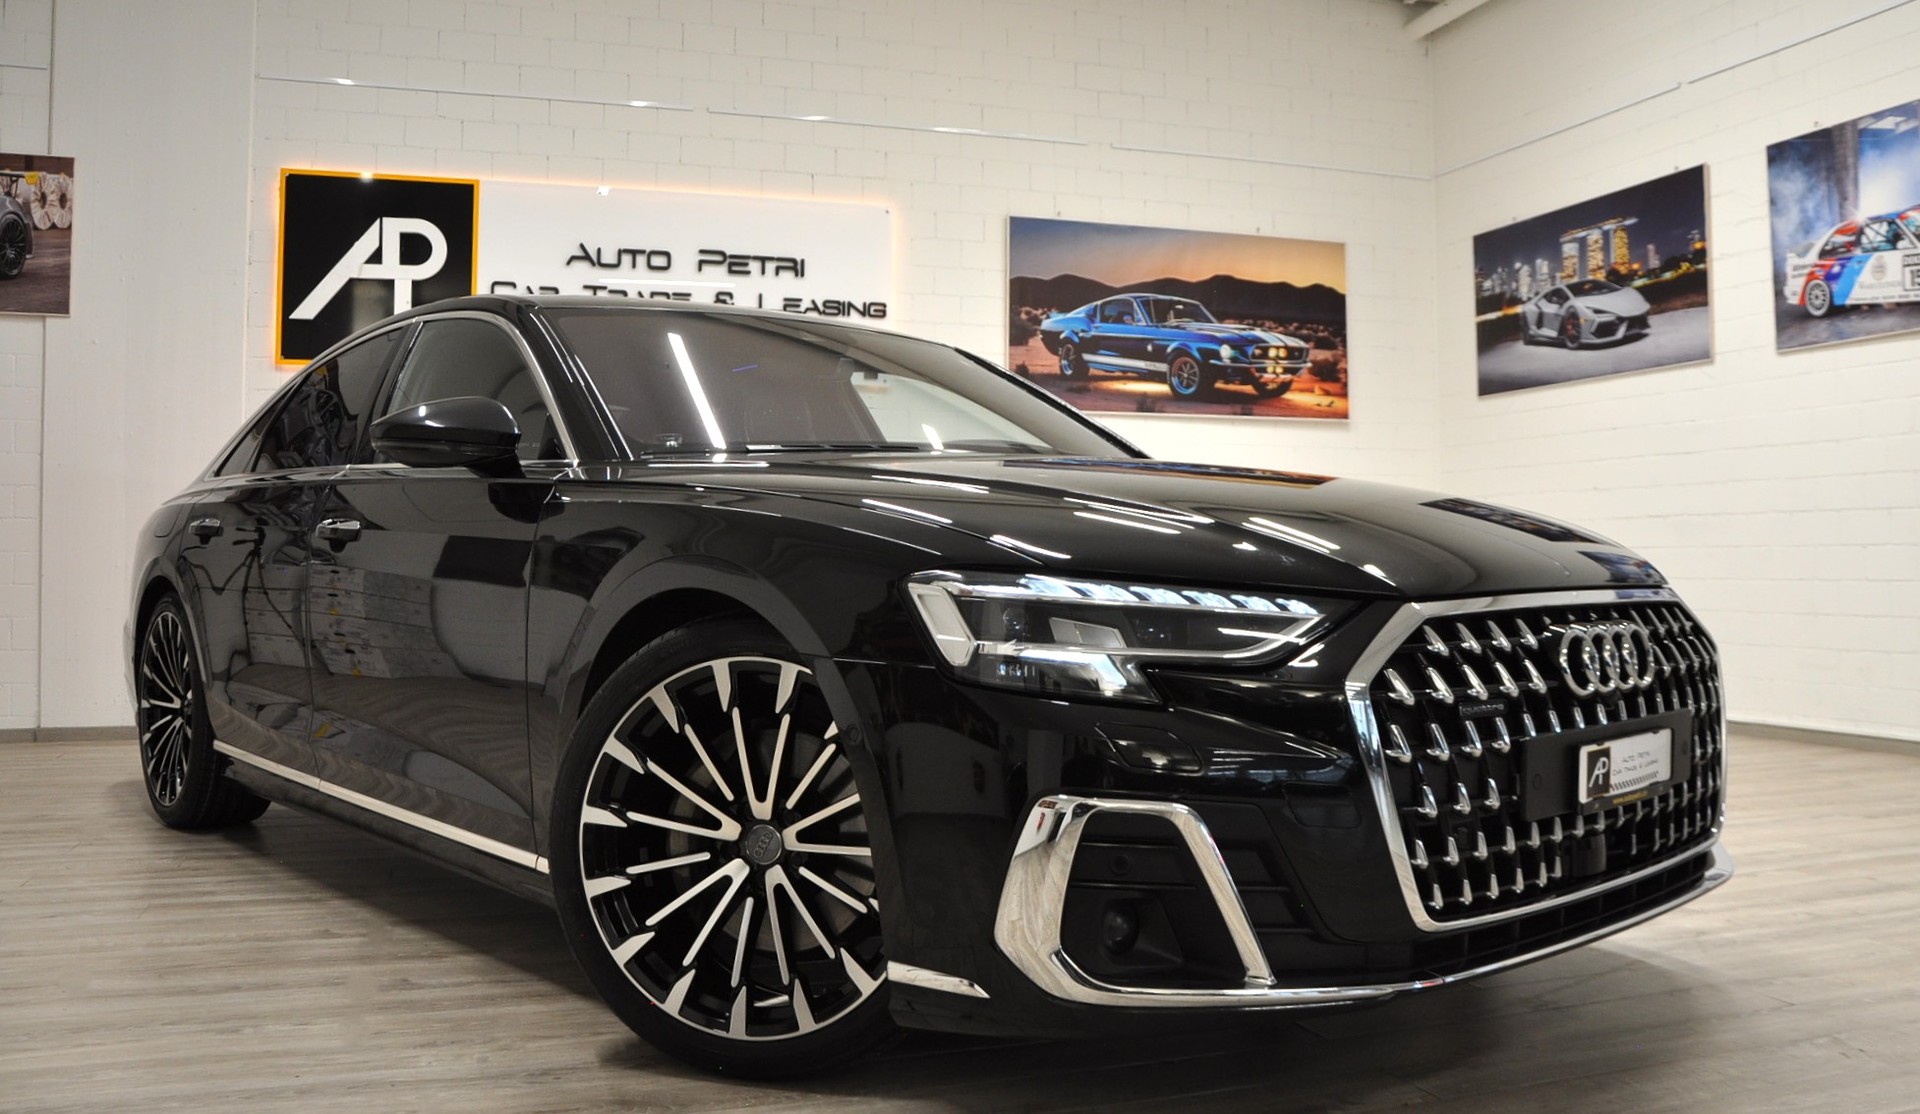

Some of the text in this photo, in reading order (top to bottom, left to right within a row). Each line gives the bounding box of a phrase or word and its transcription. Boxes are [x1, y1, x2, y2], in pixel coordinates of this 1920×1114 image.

[288, 216, 448, 321] AP
[566, 242, 805, 278] AUTO PETRI
